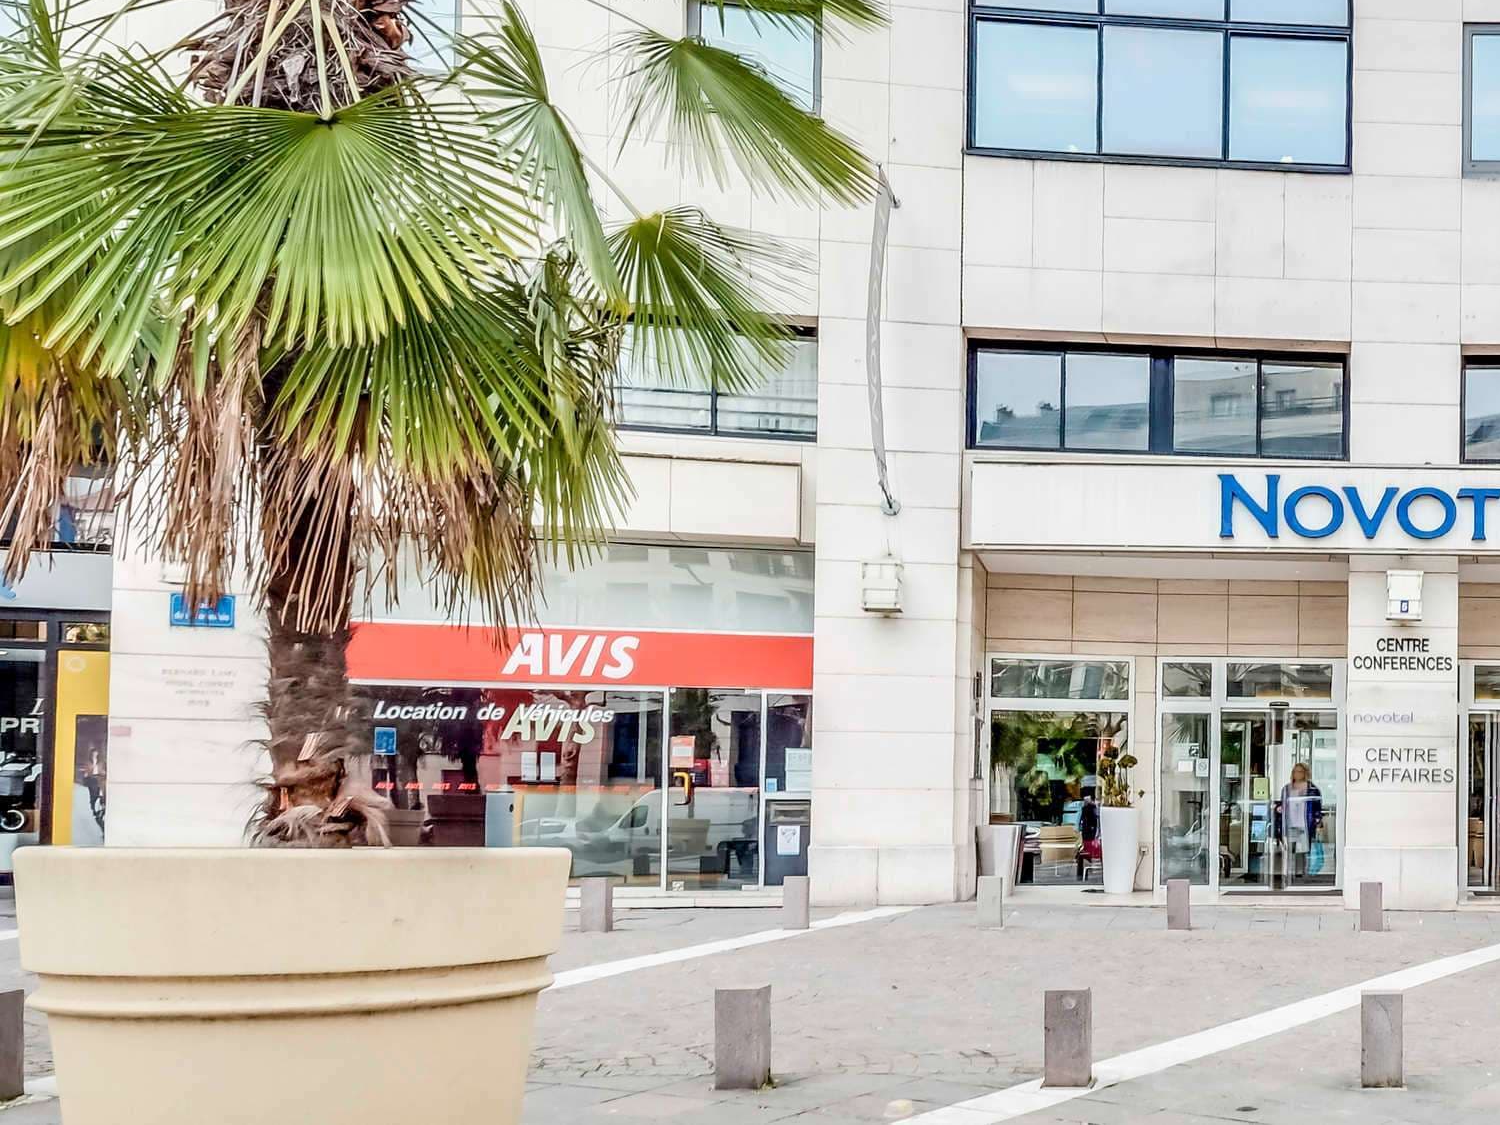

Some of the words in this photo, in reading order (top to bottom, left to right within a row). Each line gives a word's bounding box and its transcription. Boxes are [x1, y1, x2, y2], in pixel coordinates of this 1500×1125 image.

[1376, 638, 1430, 652] CENTRE
[501, 633, 640, 679] AVIS
[1353, 656, 1453, 671] CONFERENCES
[373, 700, 466, 721] Location
[477, 702, 506, 722] de
[518, 703, 615, 724] Véhicules
[1353, 711, 1414, 723] novotel
[1365, 748, 1438, 762] CENTRE
[1368, 768, 1454, 783] AFFAIRES
